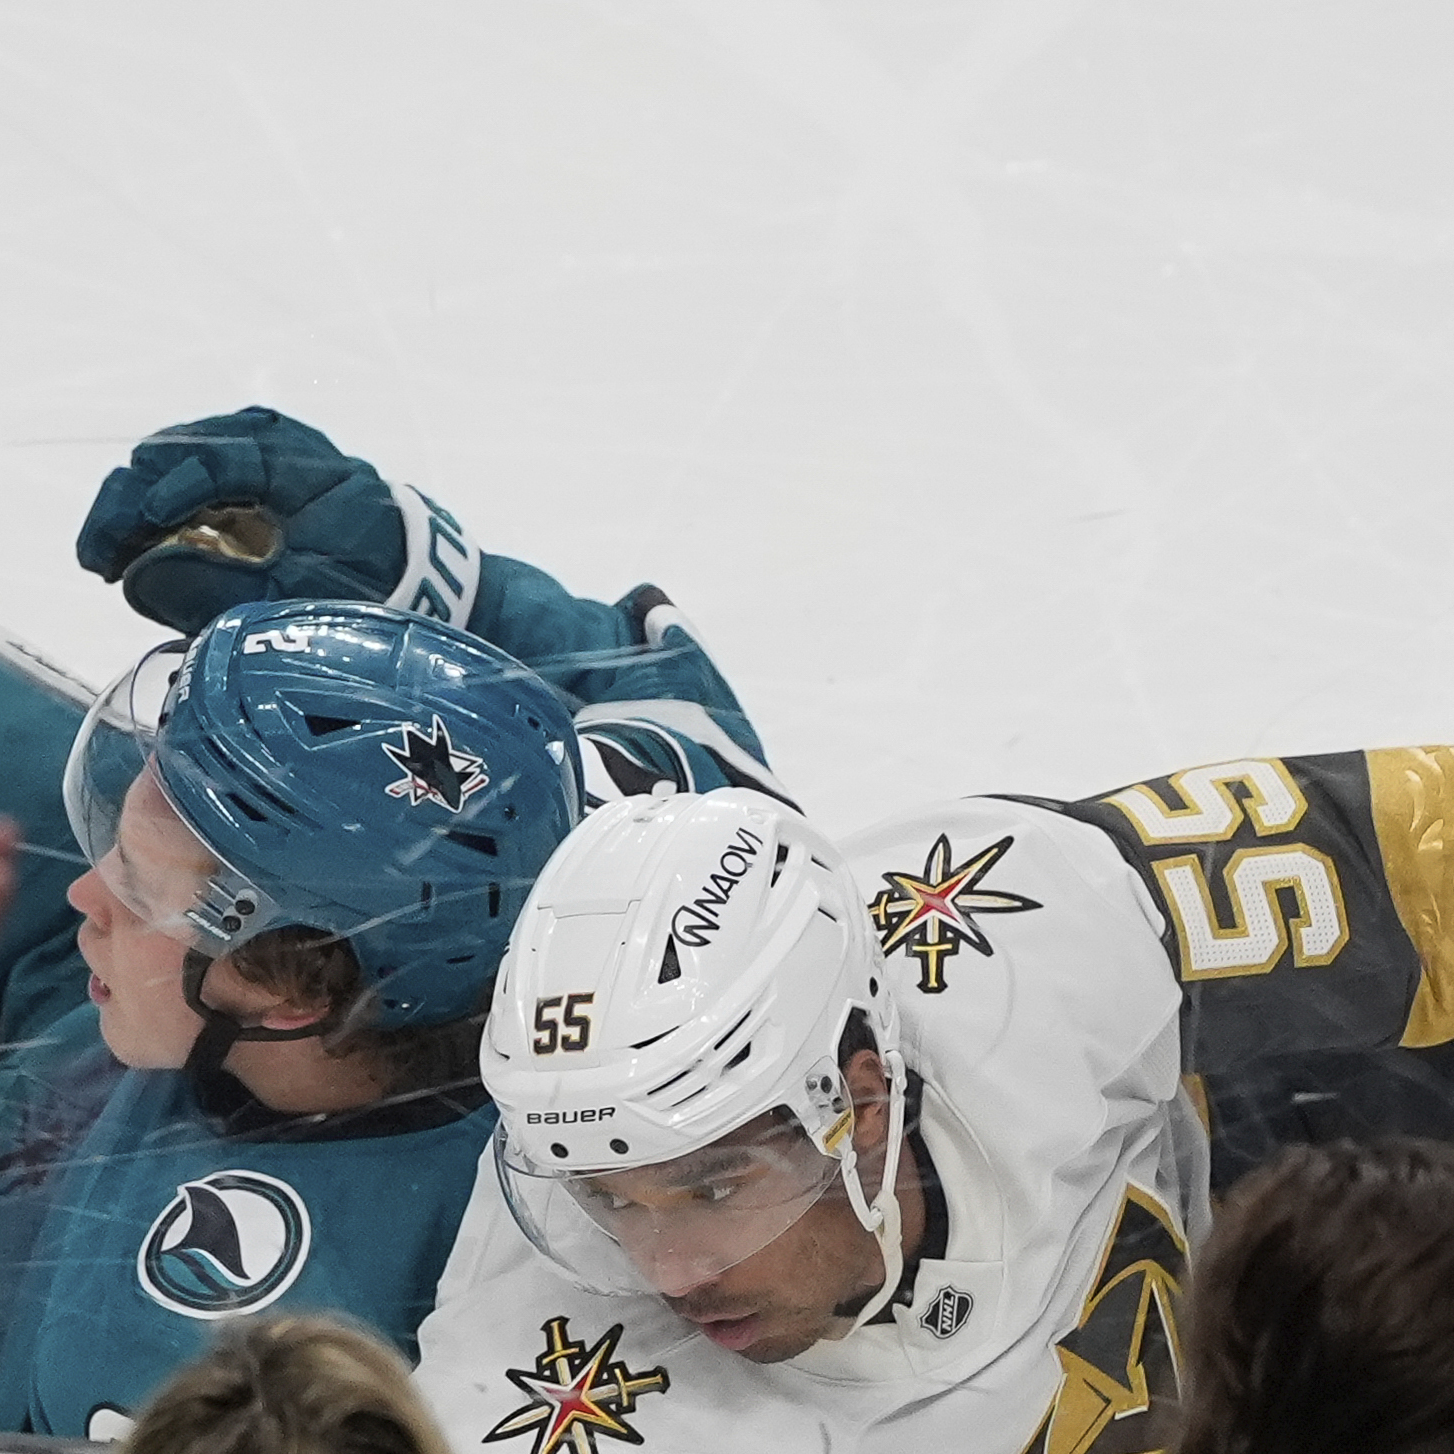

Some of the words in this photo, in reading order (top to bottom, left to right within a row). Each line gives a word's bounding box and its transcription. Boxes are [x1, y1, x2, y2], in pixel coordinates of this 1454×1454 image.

[1098, 757, 1349, 981] 55
[532, 992, 595, 1055] 55
[527, 1106, 617, 1125] BAUER
[941, 1295, 955, 1332] NHL
